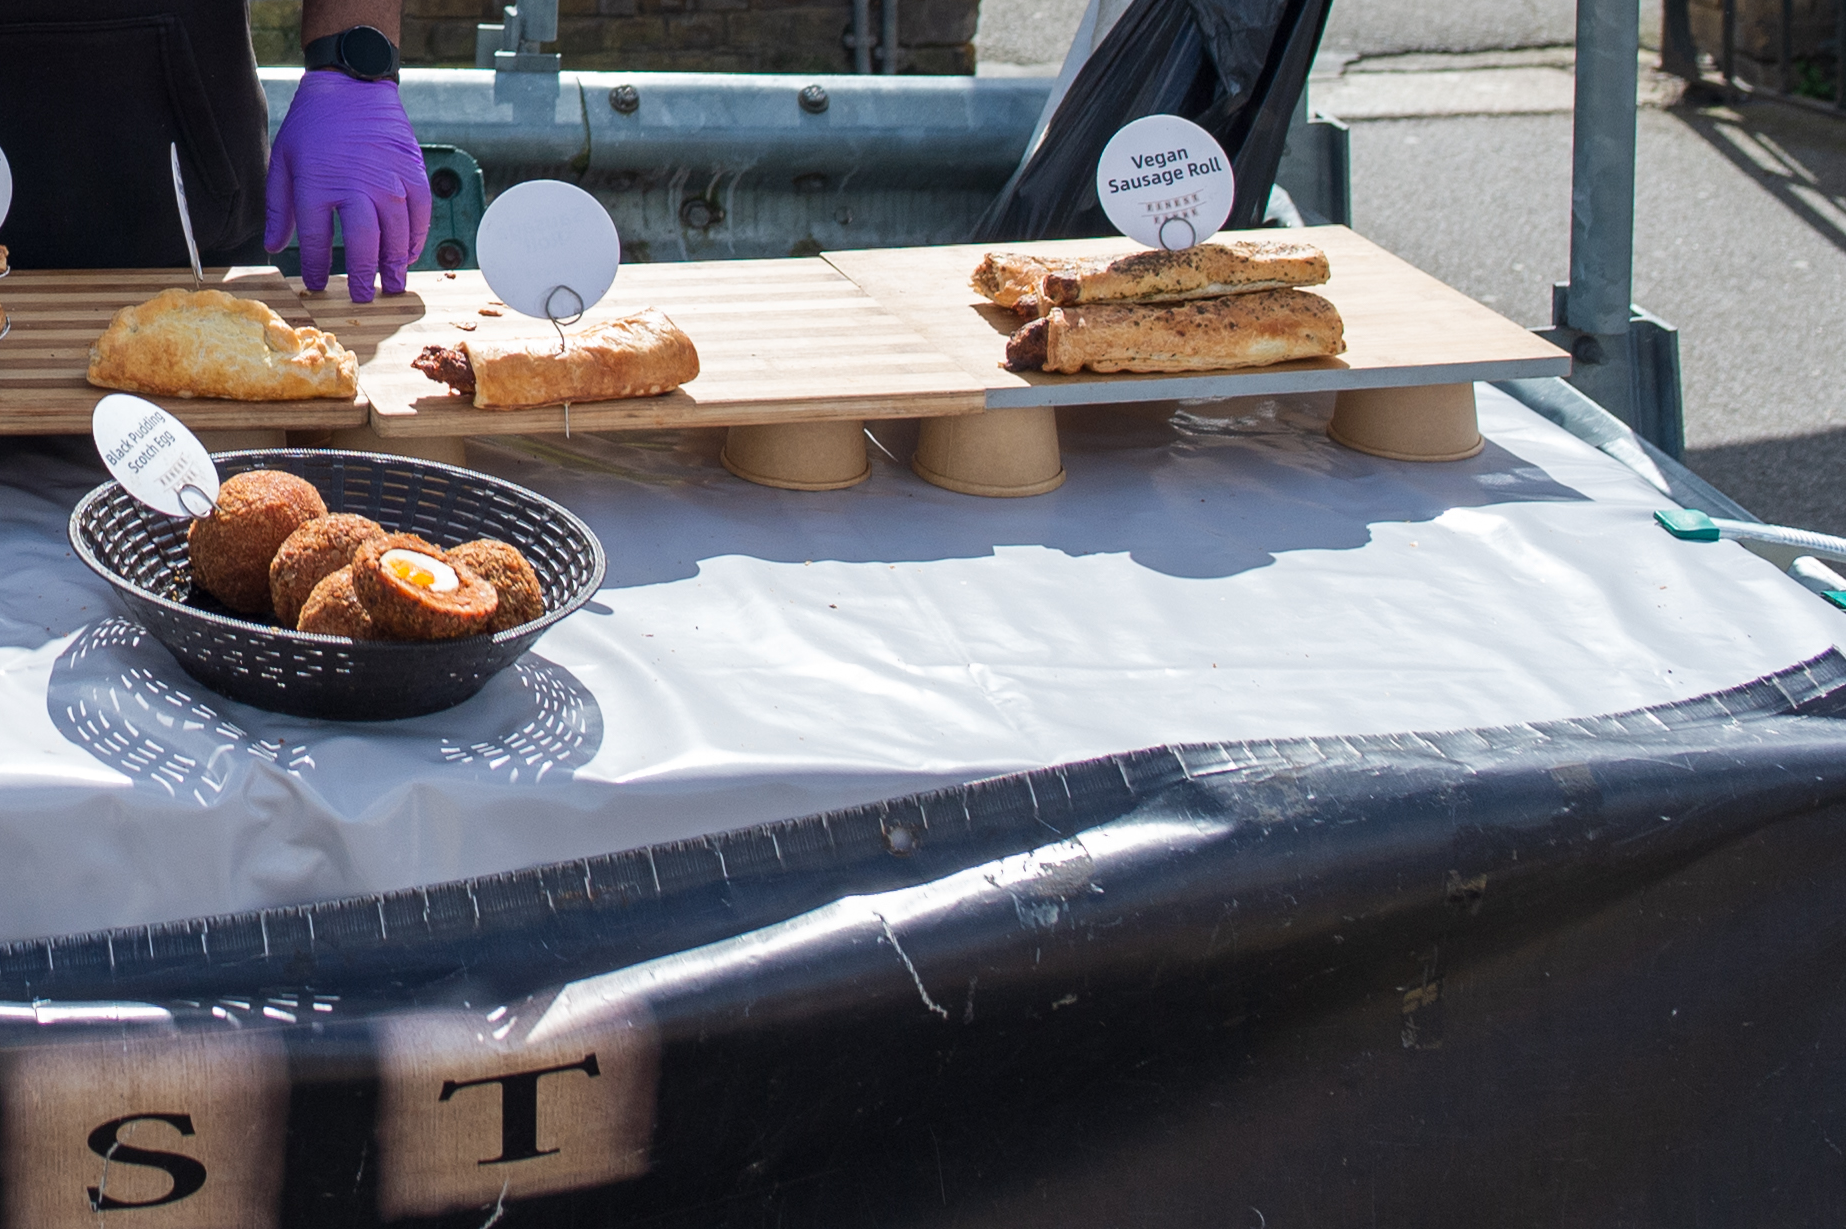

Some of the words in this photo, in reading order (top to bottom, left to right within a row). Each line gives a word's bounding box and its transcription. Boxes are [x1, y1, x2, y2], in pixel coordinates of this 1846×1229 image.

[1108, 167, 1184, 194] Sausage
[1187, 156, 1222, 177] Roll
[1131, 148, 1189, 169] Vegan
[106, 439, 134, 467] Black
[128, 411, 166, 444] Pudding
[128, 442, 160, 474] Scotch
[154, 430, 176, 449] Egg
